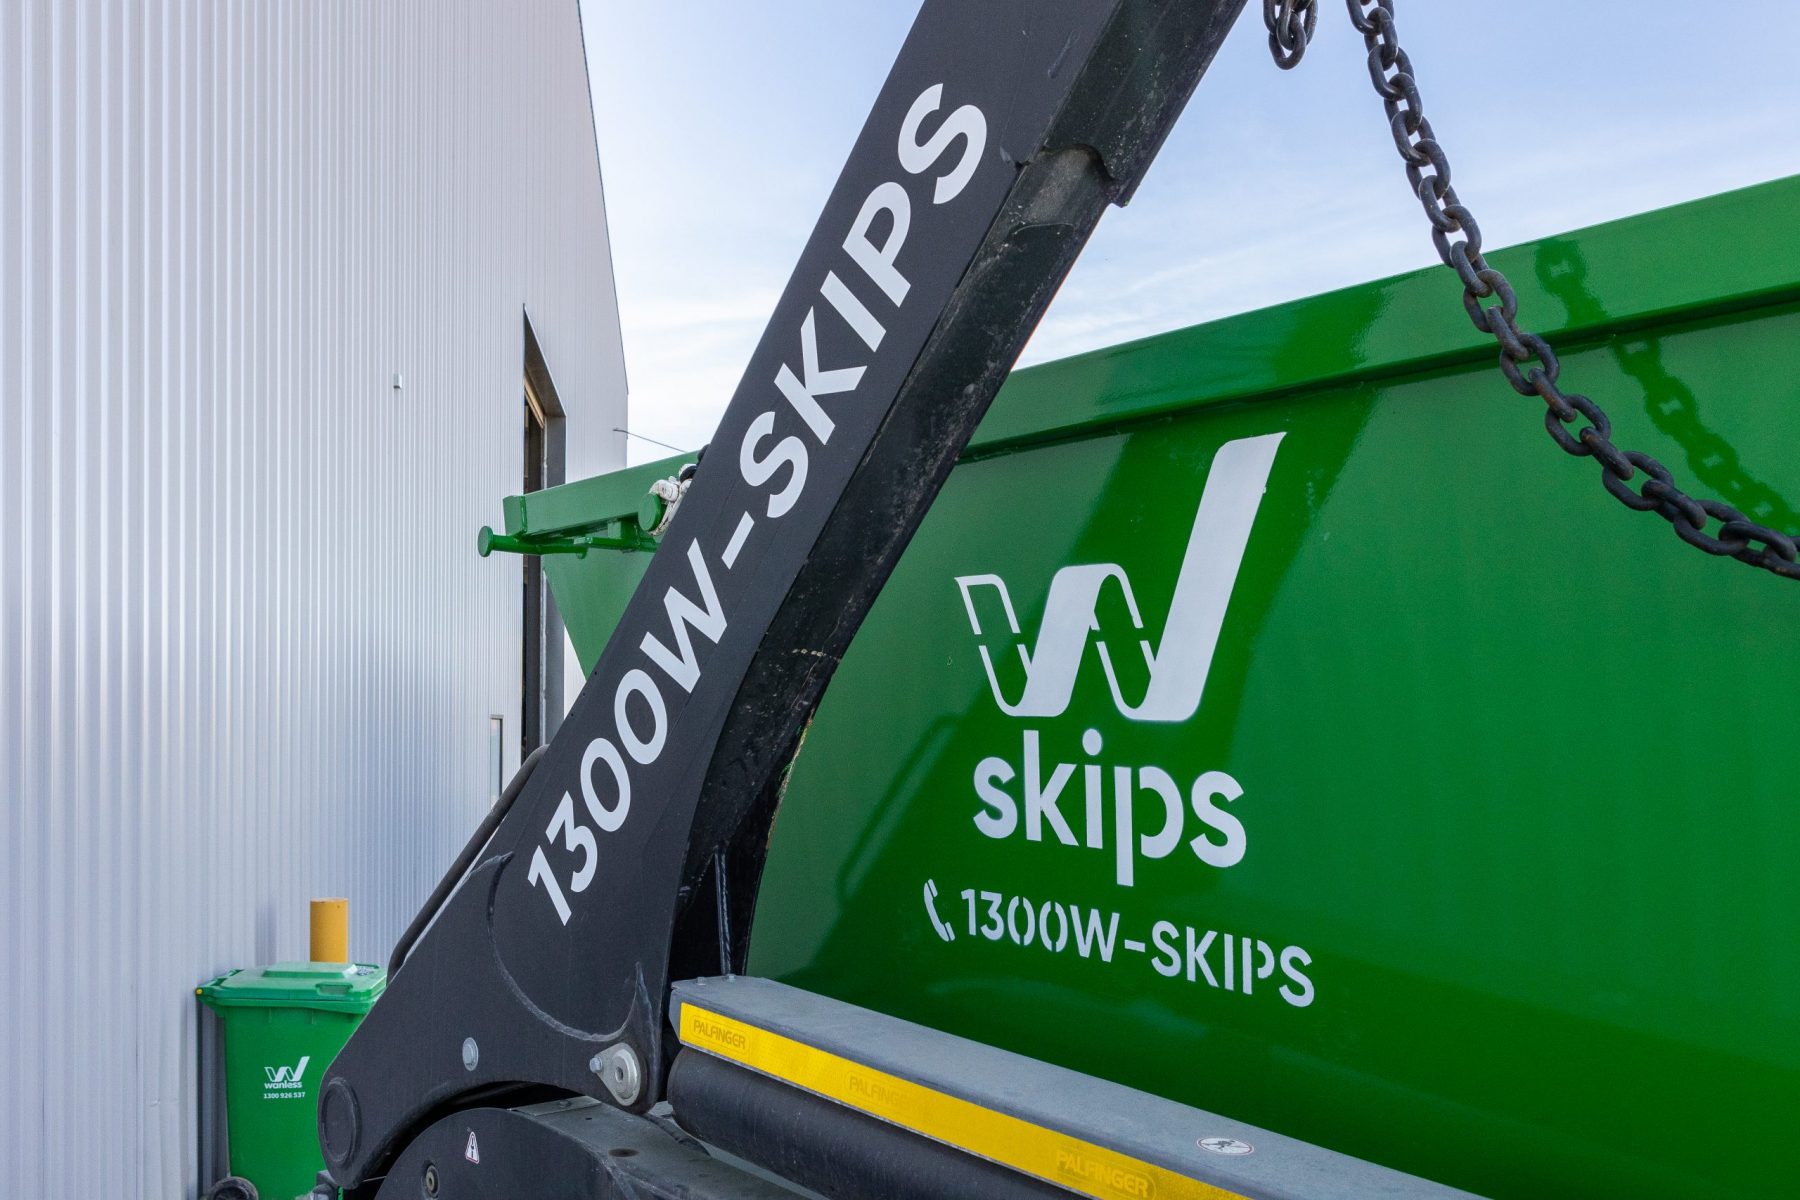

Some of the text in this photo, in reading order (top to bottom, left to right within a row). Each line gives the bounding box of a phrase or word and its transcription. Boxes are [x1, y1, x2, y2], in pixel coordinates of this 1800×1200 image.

[527, 82, 988, 926] 1300W-SKIPS
[972, 728, 1247, 887] skips
[960, 889, 1315, 1007] 1300W-SKIPS
[693, 1018, 747, 1051] PALFINGER
[264, 1080, 303, 1089] wanless
[1056, 1149, 1148, 1198] PALFINGER
